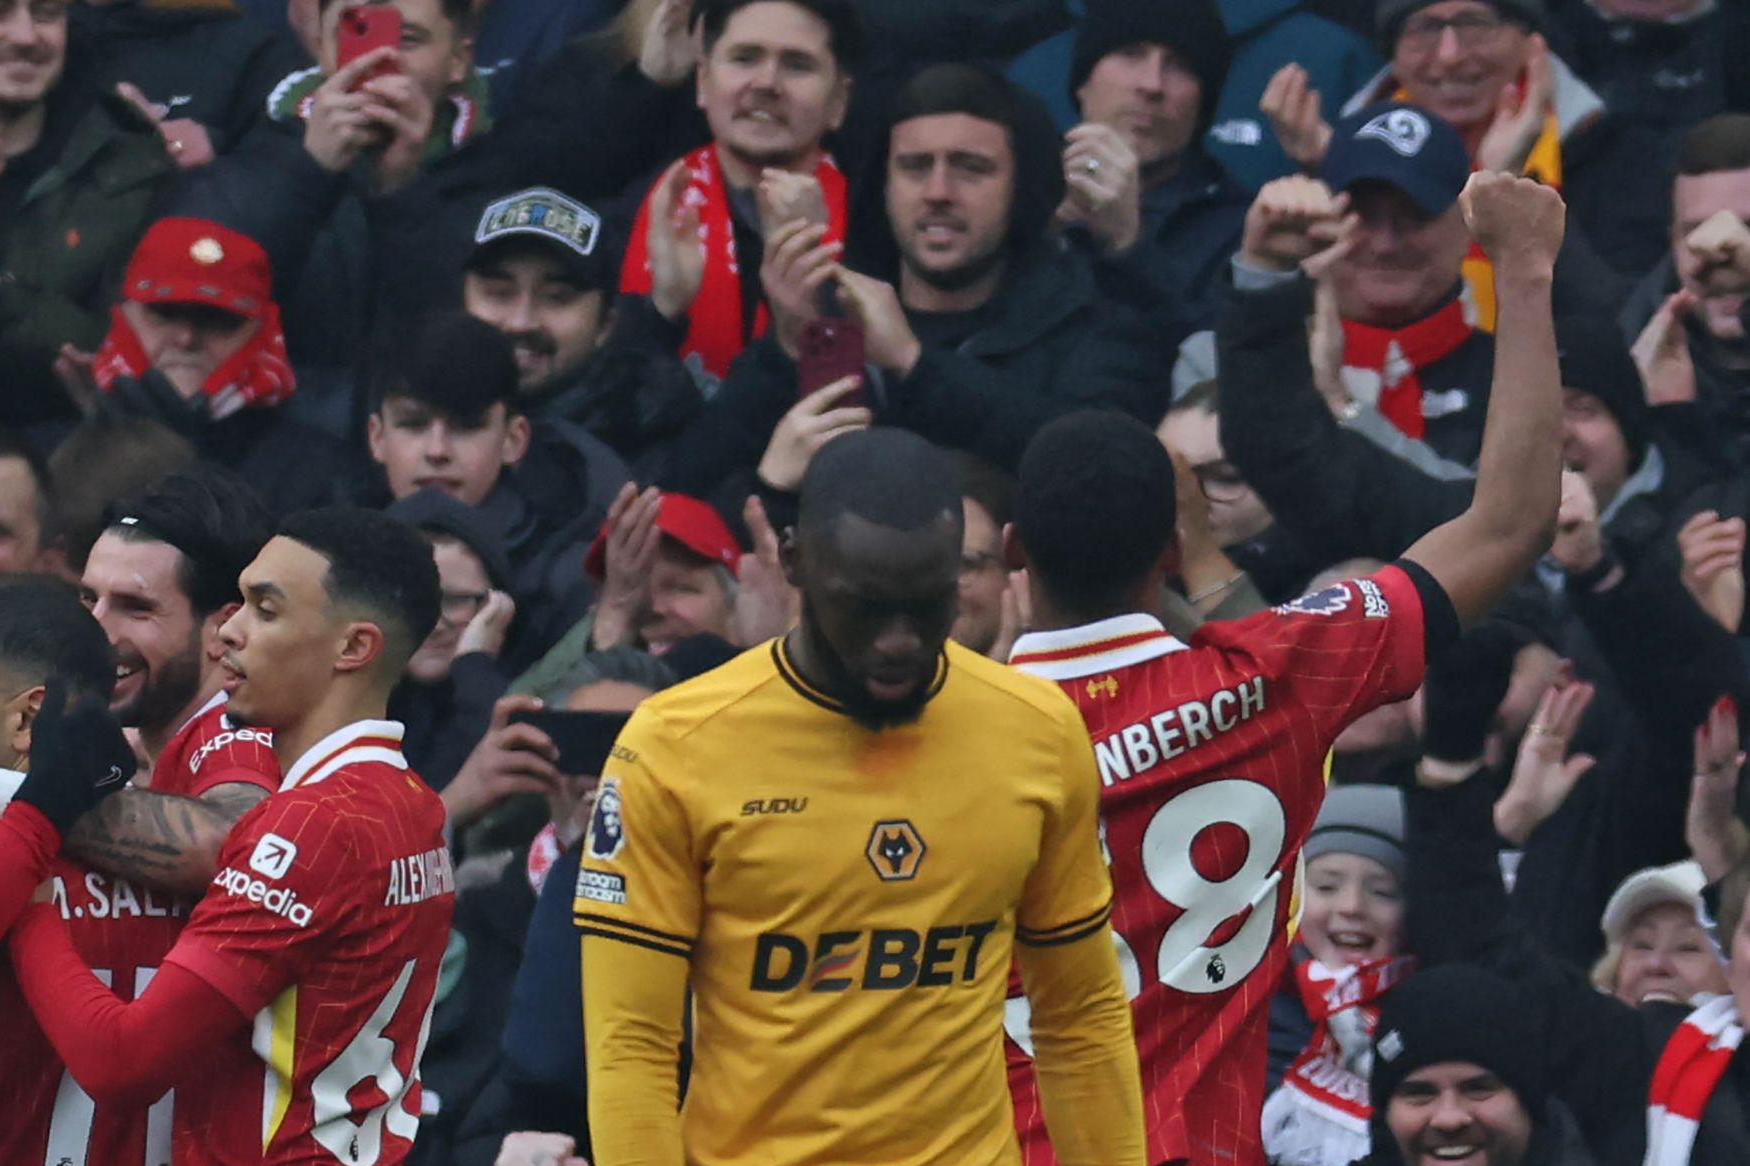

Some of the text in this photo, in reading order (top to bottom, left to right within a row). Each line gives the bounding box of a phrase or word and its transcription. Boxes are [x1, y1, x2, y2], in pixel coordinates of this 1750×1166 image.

[740, 797, 809, 816] SUDU
[51, 872, 181, 920] .SAL
[749, 919, 999, 994] DEBET
